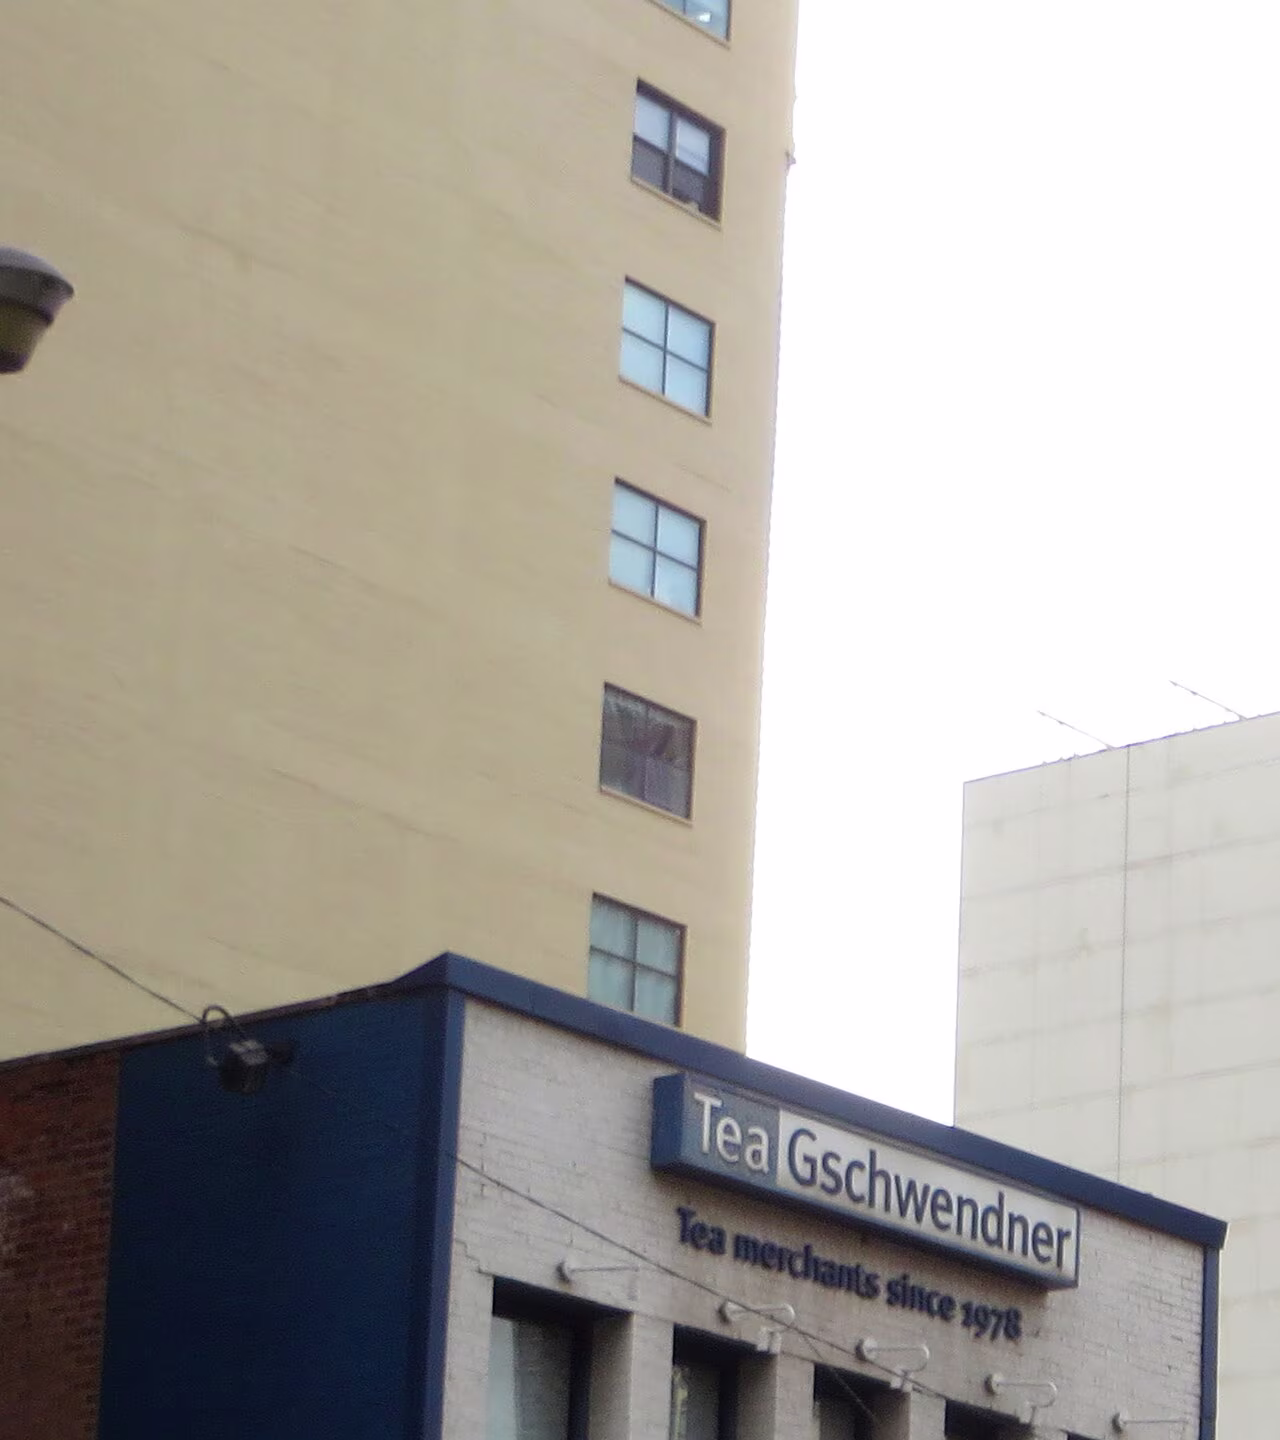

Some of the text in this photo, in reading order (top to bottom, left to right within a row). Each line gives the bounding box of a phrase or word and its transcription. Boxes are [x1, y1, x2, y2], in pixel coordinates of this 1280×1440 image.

[694, 1092, 1072, 1271] Tea Gschwendner
[676, 1203, 1022, 1341] Tea merchants since 1978
